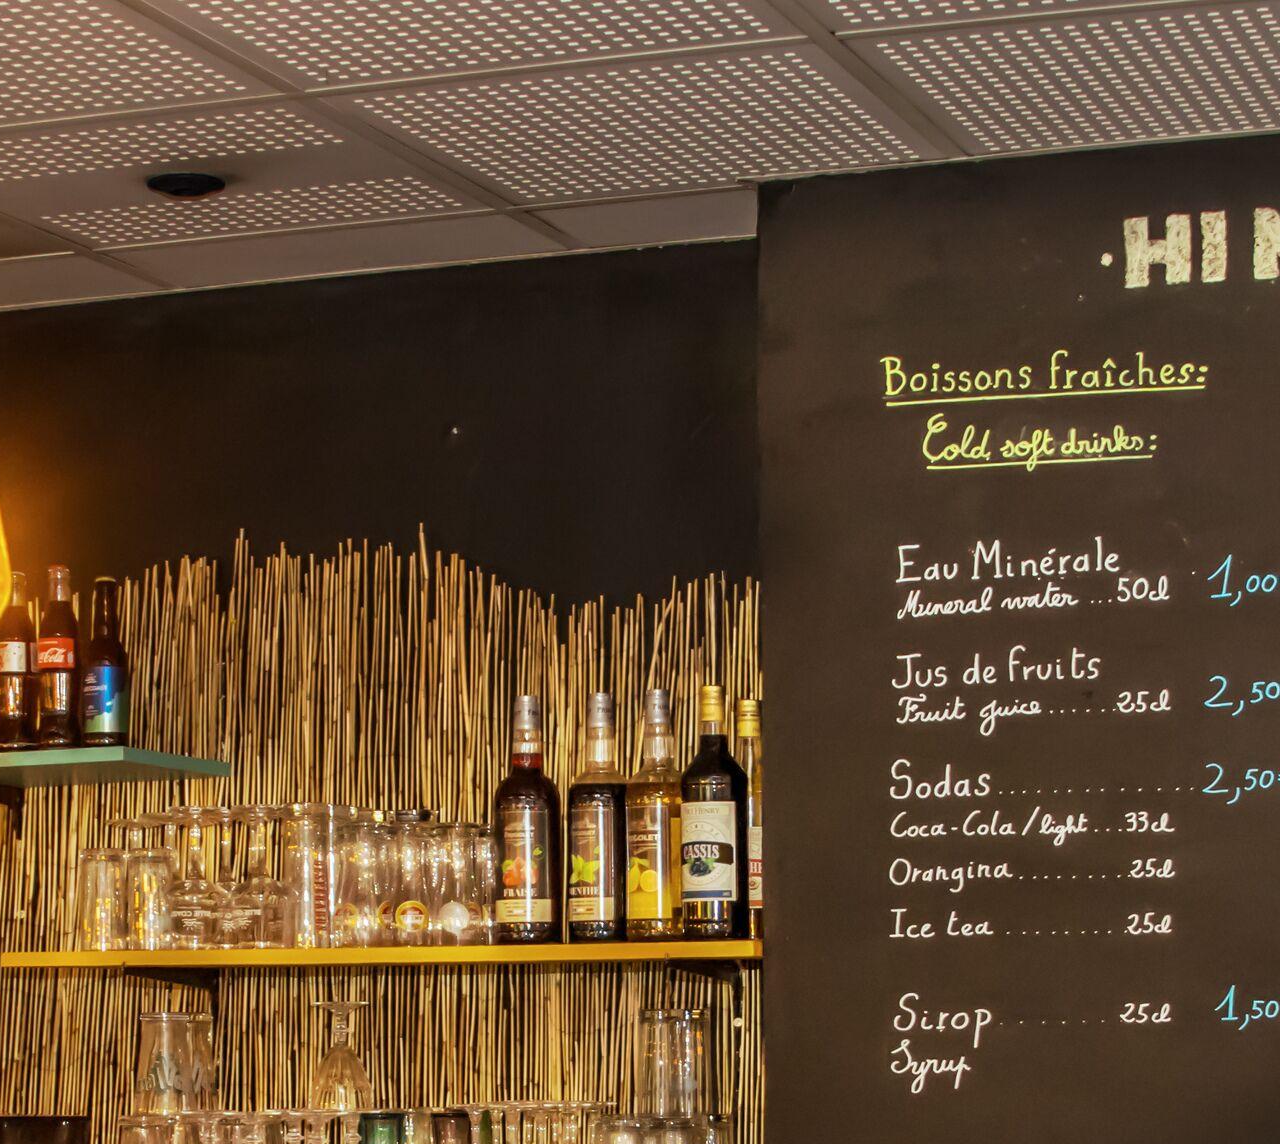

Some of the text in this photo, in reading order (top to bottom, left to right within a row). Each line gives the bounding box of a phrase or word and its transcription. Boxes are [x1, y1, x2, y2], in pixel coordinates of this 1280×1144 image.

[1124, 211, 1227, 288] HI
[881, 350, 1208, 396] Boissons fraîches:
[922, 413, 990, 462] Cold
[1000, 427, 1055, 471] soft
[895, 536, 1120, 583] Eau Minérale
[1001, 583, 1079, 612] water
[892, 645, 1102, 689] Jus de fruits
[897, 694, 966, 724] Fruit
[979, 698, 1042, 736] juice
[890, 759, 991, 800] Sodas
[683, 844, 720, 860] CASSIS
[889, 858, 1013, 893] Orangina
[889, 908, 936, 938] Ice
[946, 911, 994, 936] tea
[894, 993, 993, 1048] Sirop
[891, 1039, 971, 1094] Syrup
